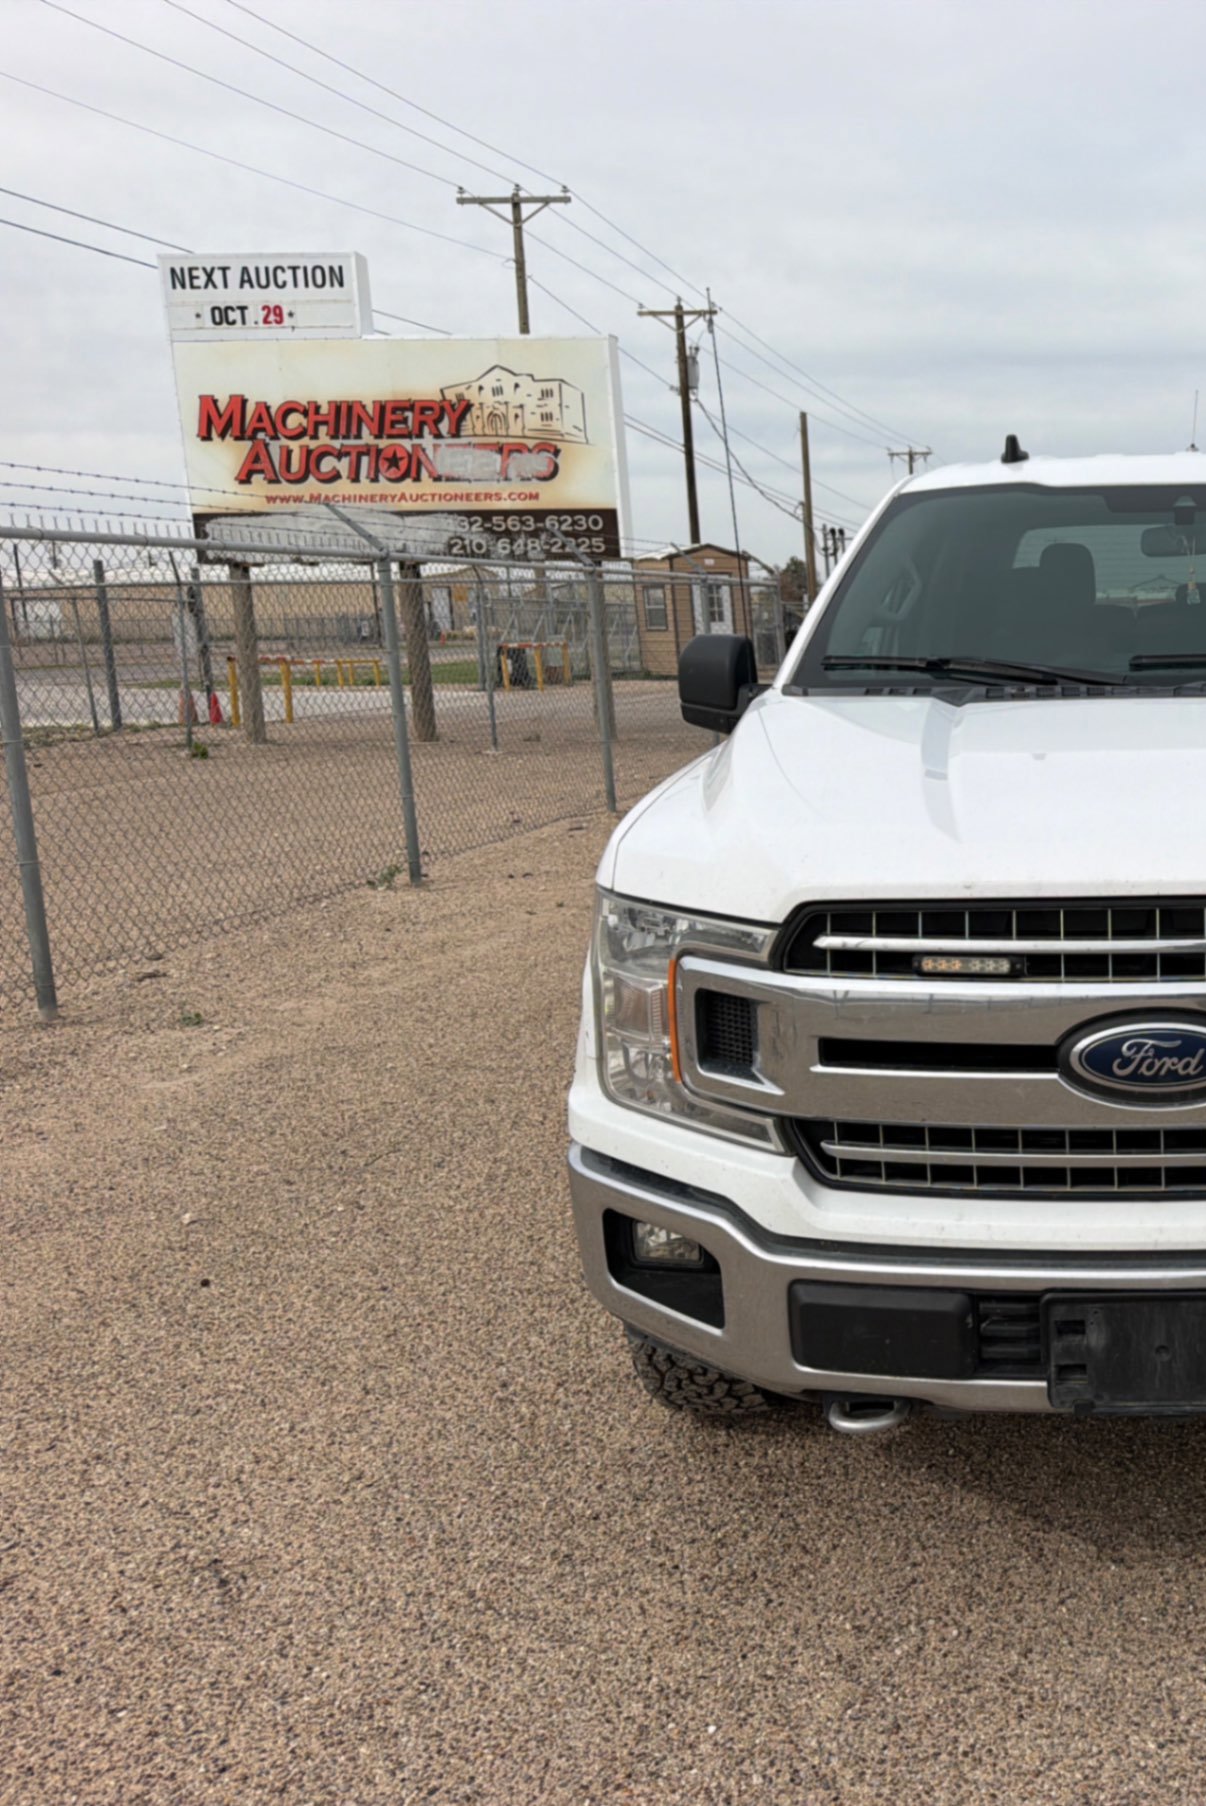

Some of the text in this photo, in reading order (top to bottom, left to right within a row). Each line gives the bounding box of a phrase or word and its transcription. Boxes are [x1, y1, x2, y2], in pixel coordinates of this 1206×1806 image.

[170, 265, 344, 290] NEXT AUCTION
[262, 305, 284, 325] 29
[197, 394, 471, 441] MACHINERY
[235, 439, 560, 484] AUCTIONRS
[1112, 1038, 1206, 1077] Ford
